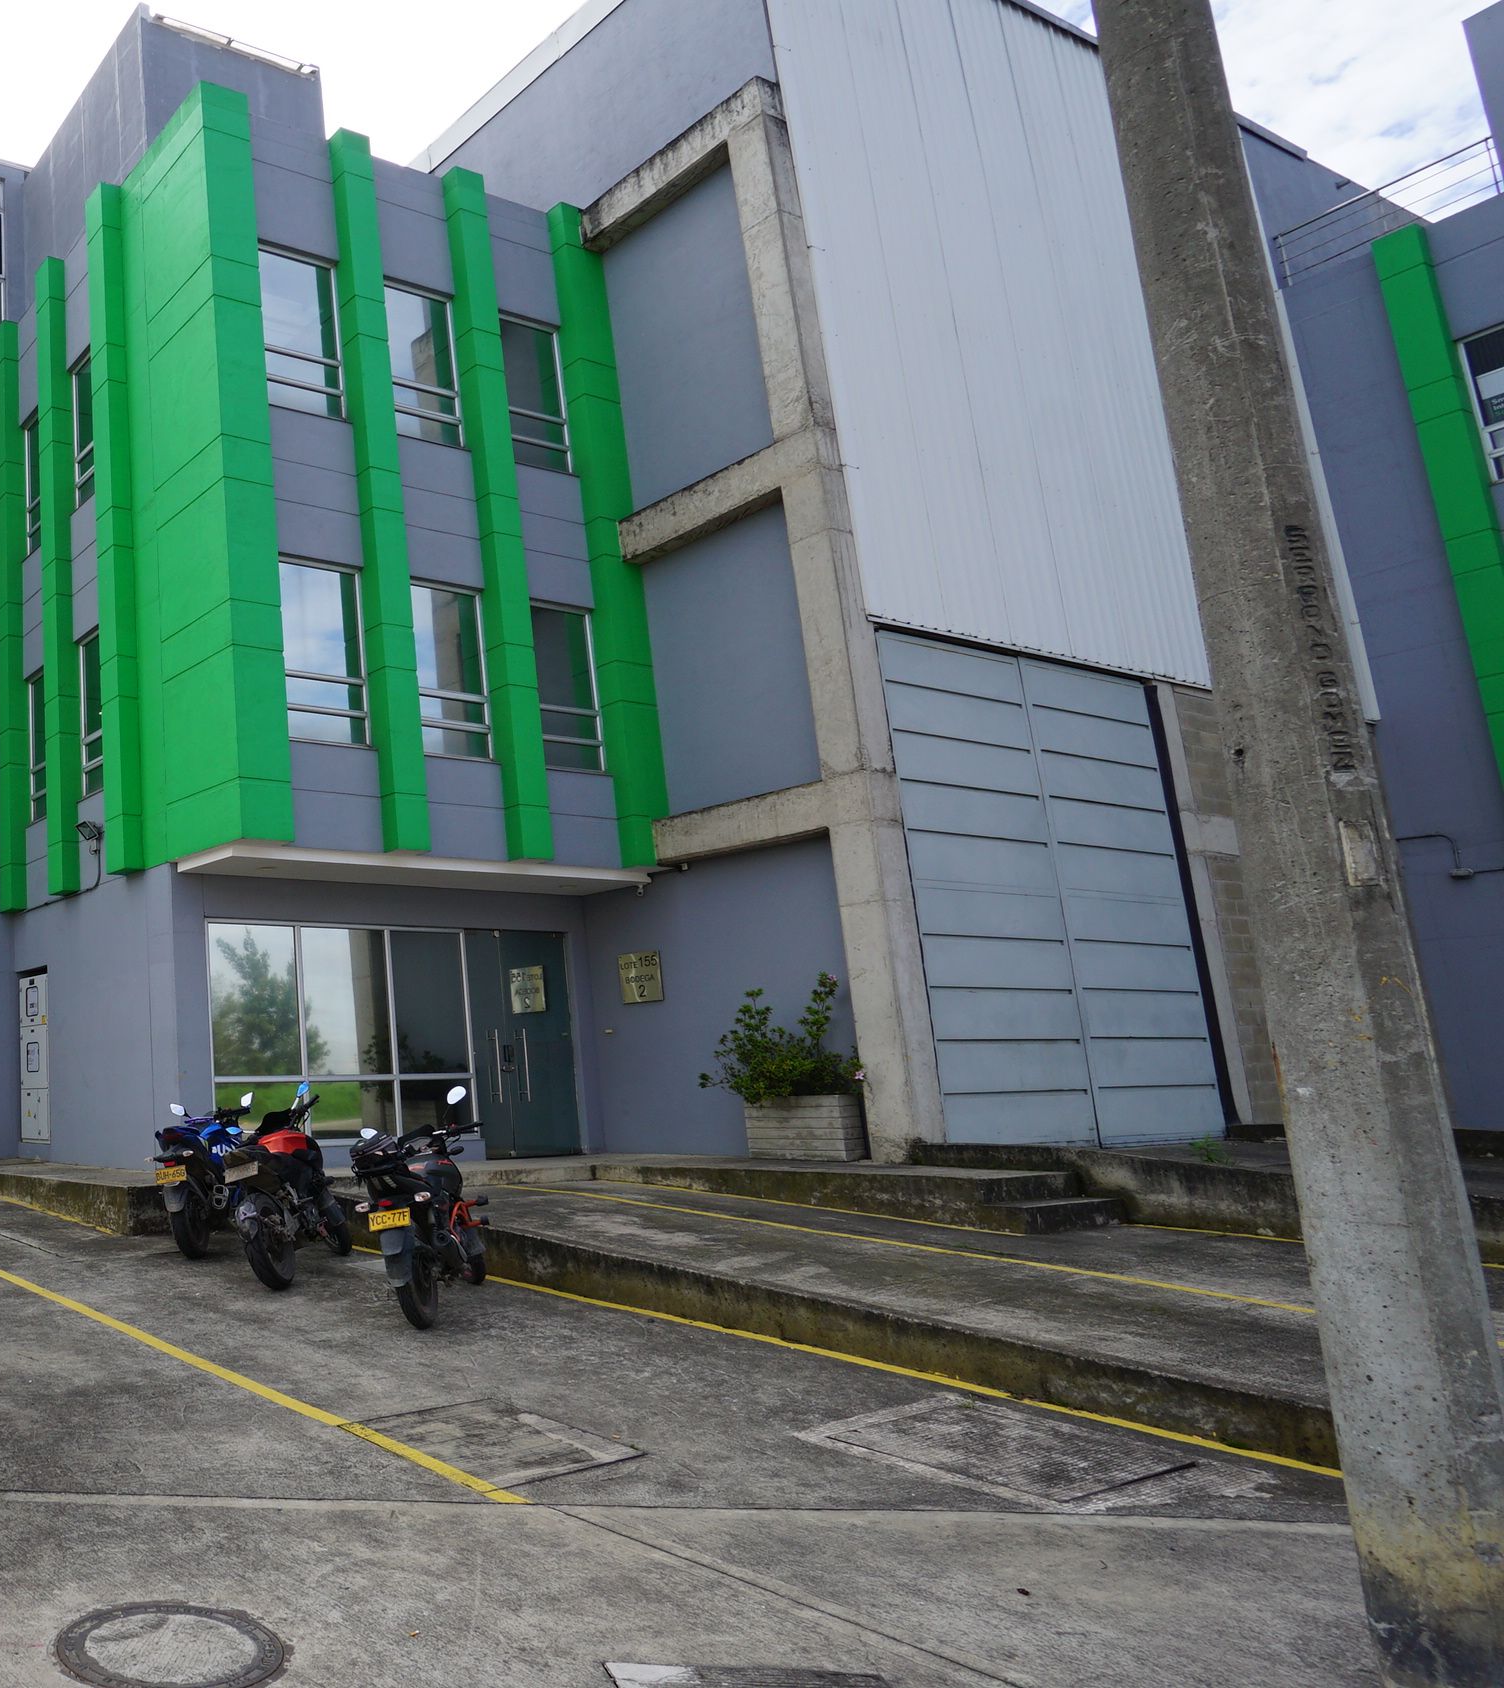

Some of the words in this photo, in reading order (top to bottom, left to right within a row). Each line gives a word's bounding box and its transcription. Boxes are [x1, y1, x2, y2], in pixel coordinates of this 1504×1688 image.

[620, 961, 638, 971] LOTE
[638, 954, 658, 969] 155
[625, 974, 655, 985] BODEGA
[638, 984, 647, 998] 2
